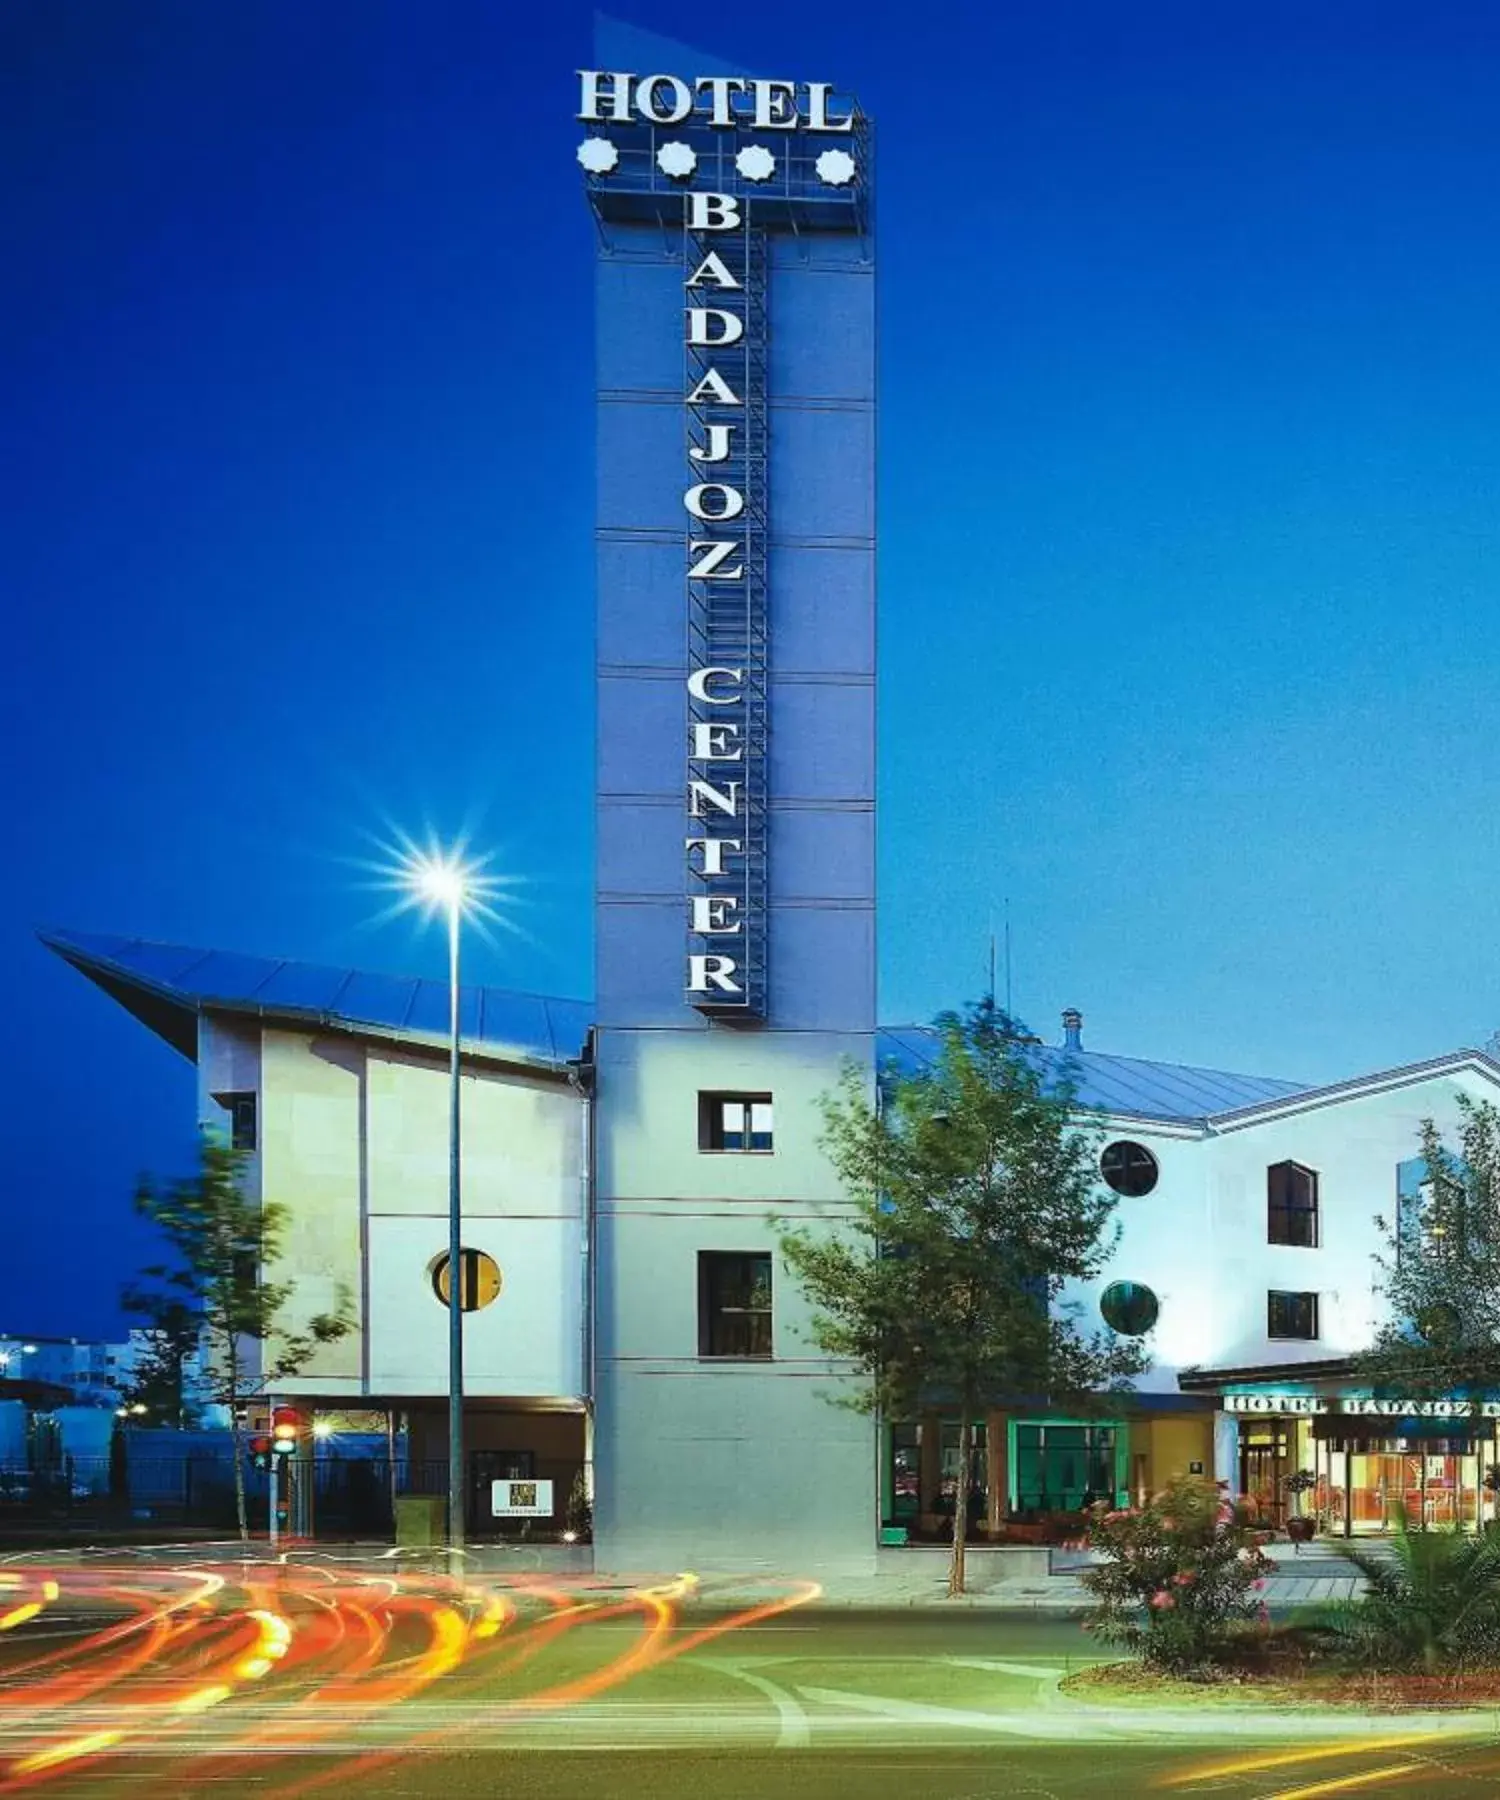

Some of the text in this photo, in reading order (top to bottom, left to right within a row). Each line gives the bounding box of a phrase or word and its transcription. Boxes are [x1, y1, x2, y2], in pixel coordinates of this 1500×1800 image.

[576, 70, 854, 132] HOTEL
[684, 192, 744, 992] BADAJOZ CENTER
[1223, 1395, 1328, 1413] HOTEL
[1342, 1399, 1472, 1417] BADAJOZ
